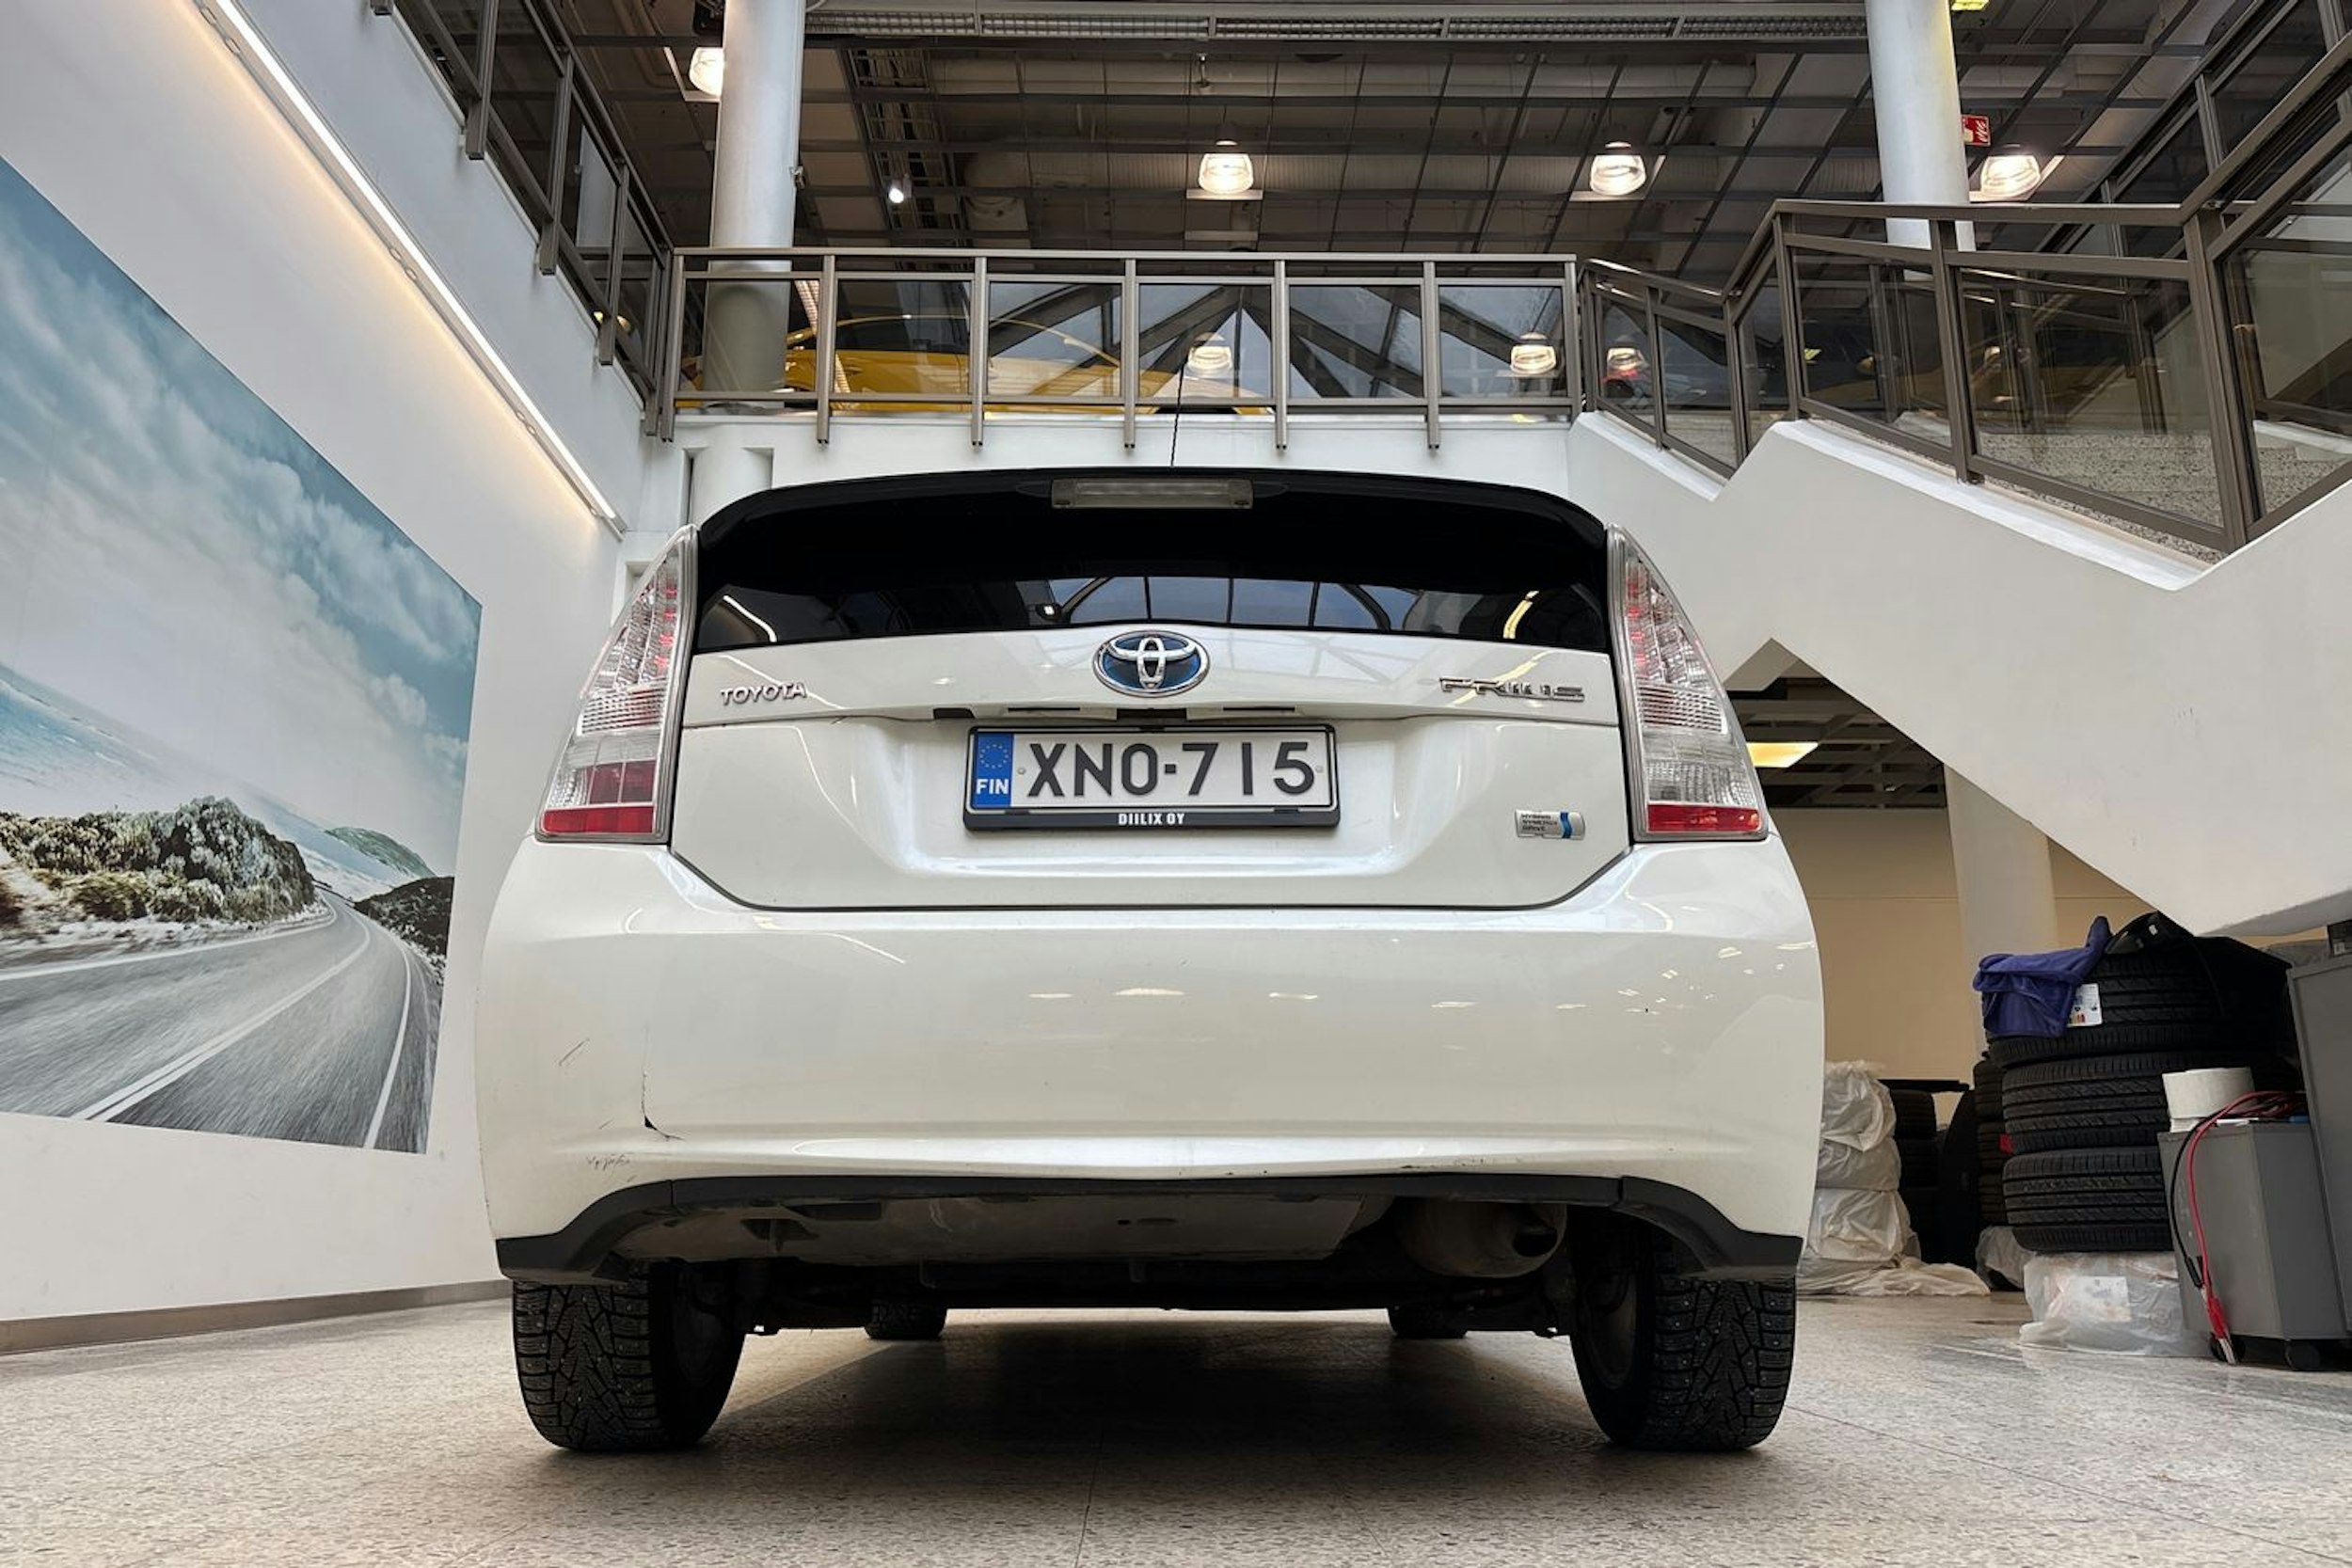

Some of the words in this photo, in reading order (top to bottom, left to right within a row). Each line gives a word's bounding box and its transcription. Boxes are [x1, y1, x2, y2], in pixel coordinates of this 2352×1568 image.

[720, 683, 807, 705] TOYOTA
[1027, 742, 1315, 797] XNO-715
[977, 778, 1009, 795] FIN
[1118, 813, 1163, 826] DIILIX
[1167, 813, 1185, 826] OY
